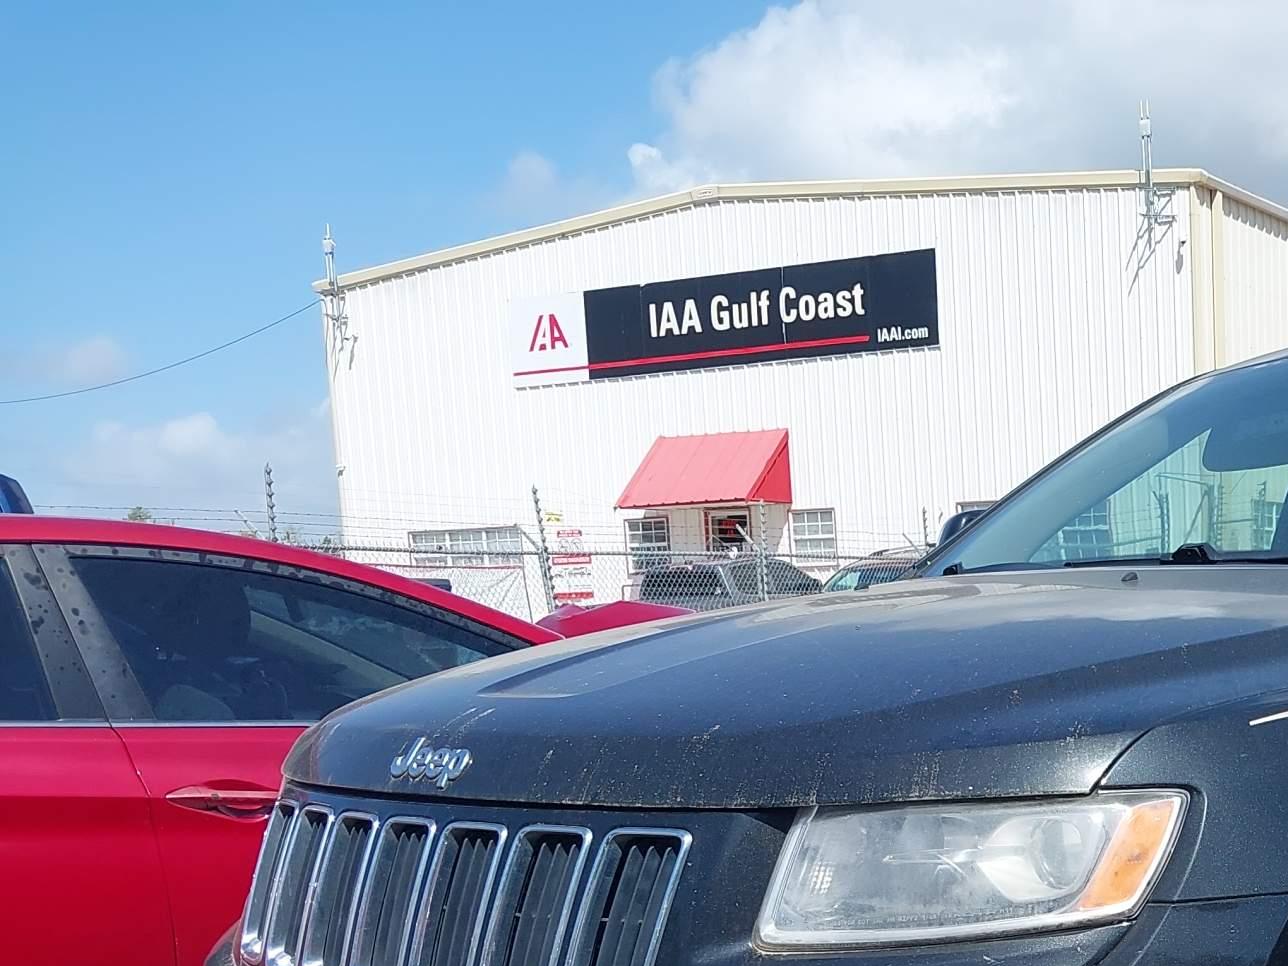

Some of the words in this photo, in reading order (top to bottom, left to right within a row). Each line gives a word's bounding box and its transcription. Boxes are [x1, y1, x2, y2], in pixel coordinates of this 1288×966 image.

[649, 302, 702, 338] IAA
[710, 289, 770, 331] Gulf
[779, 283, 865, 323] Coast
[390, 737, 473, 791] Jeep
